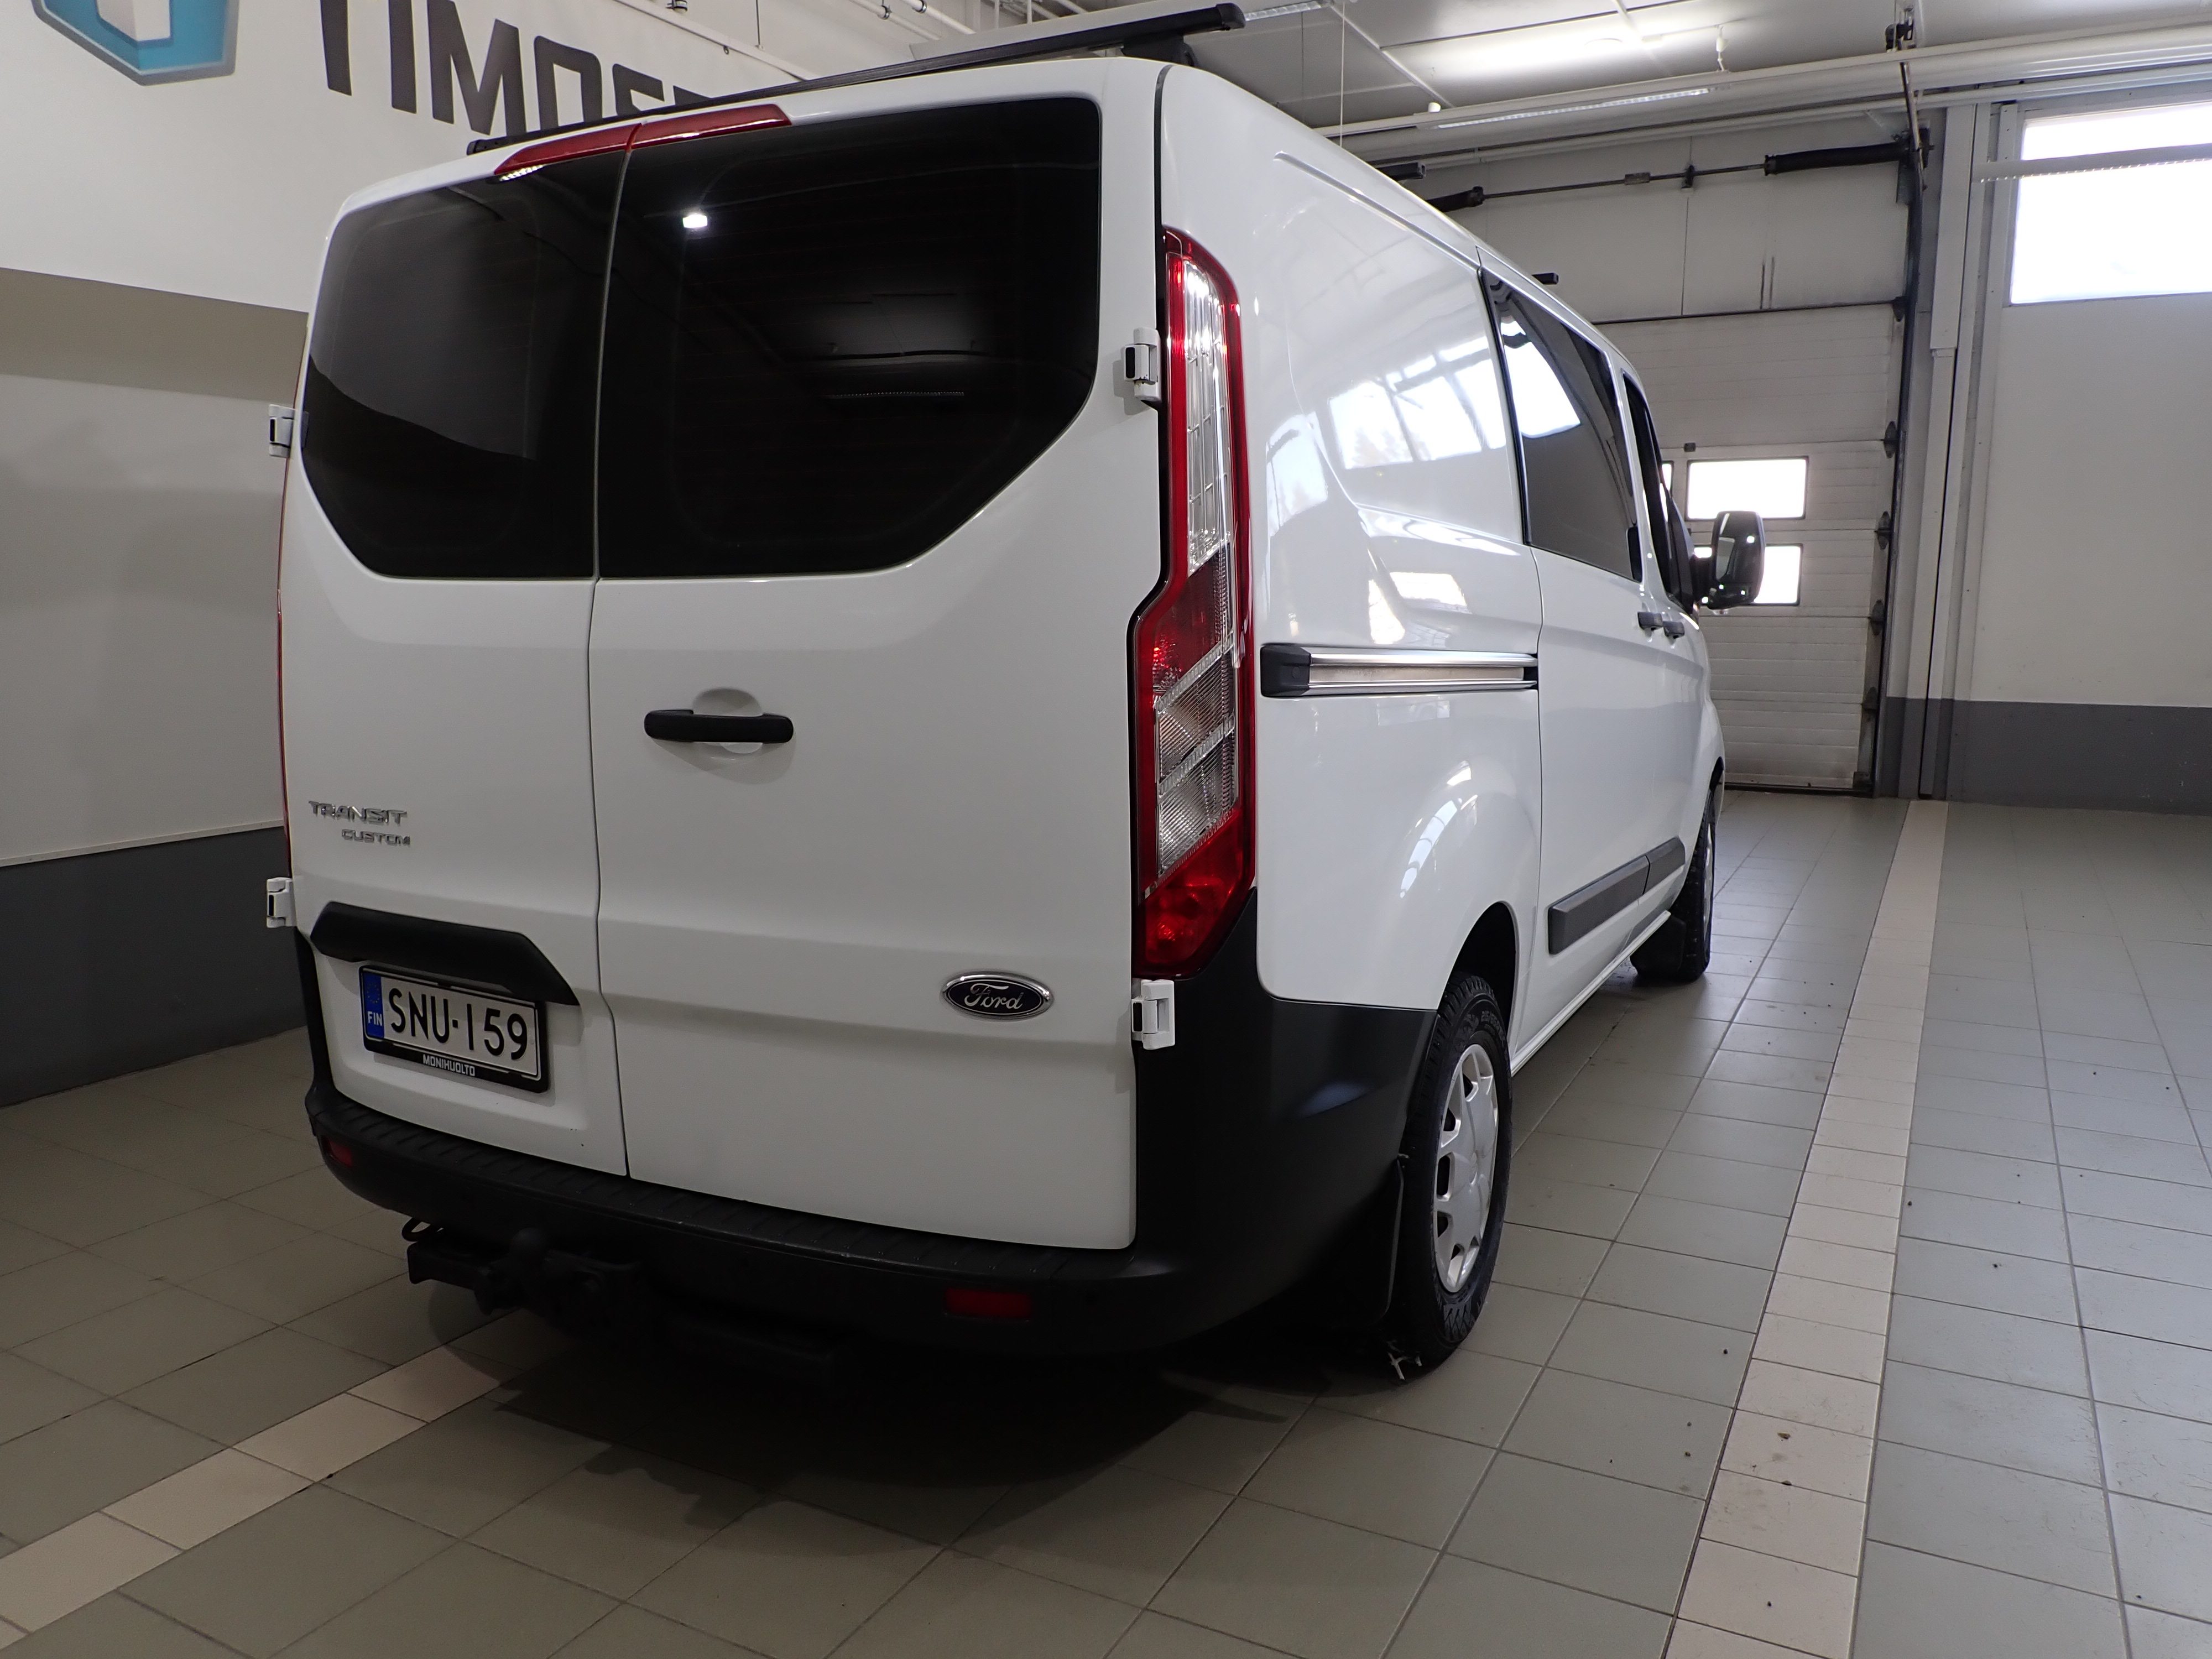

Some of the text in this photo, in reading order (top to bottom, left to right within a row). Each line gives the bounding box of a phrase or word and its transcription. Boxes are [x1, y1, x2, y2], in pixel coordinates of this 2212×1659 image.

[320, 0, 711, 137] IMO
[309, 801, 407, 824] TRANSIT
[342, 830, 410, 846] CUSTOM
[964, 983, 1024, 1009] Ford
[368, 1011, 383, 1026] FIN
[389, 988, 528, 1060] SNU-159
[422, 1054, 476, 1077] MONIHUOLTO
